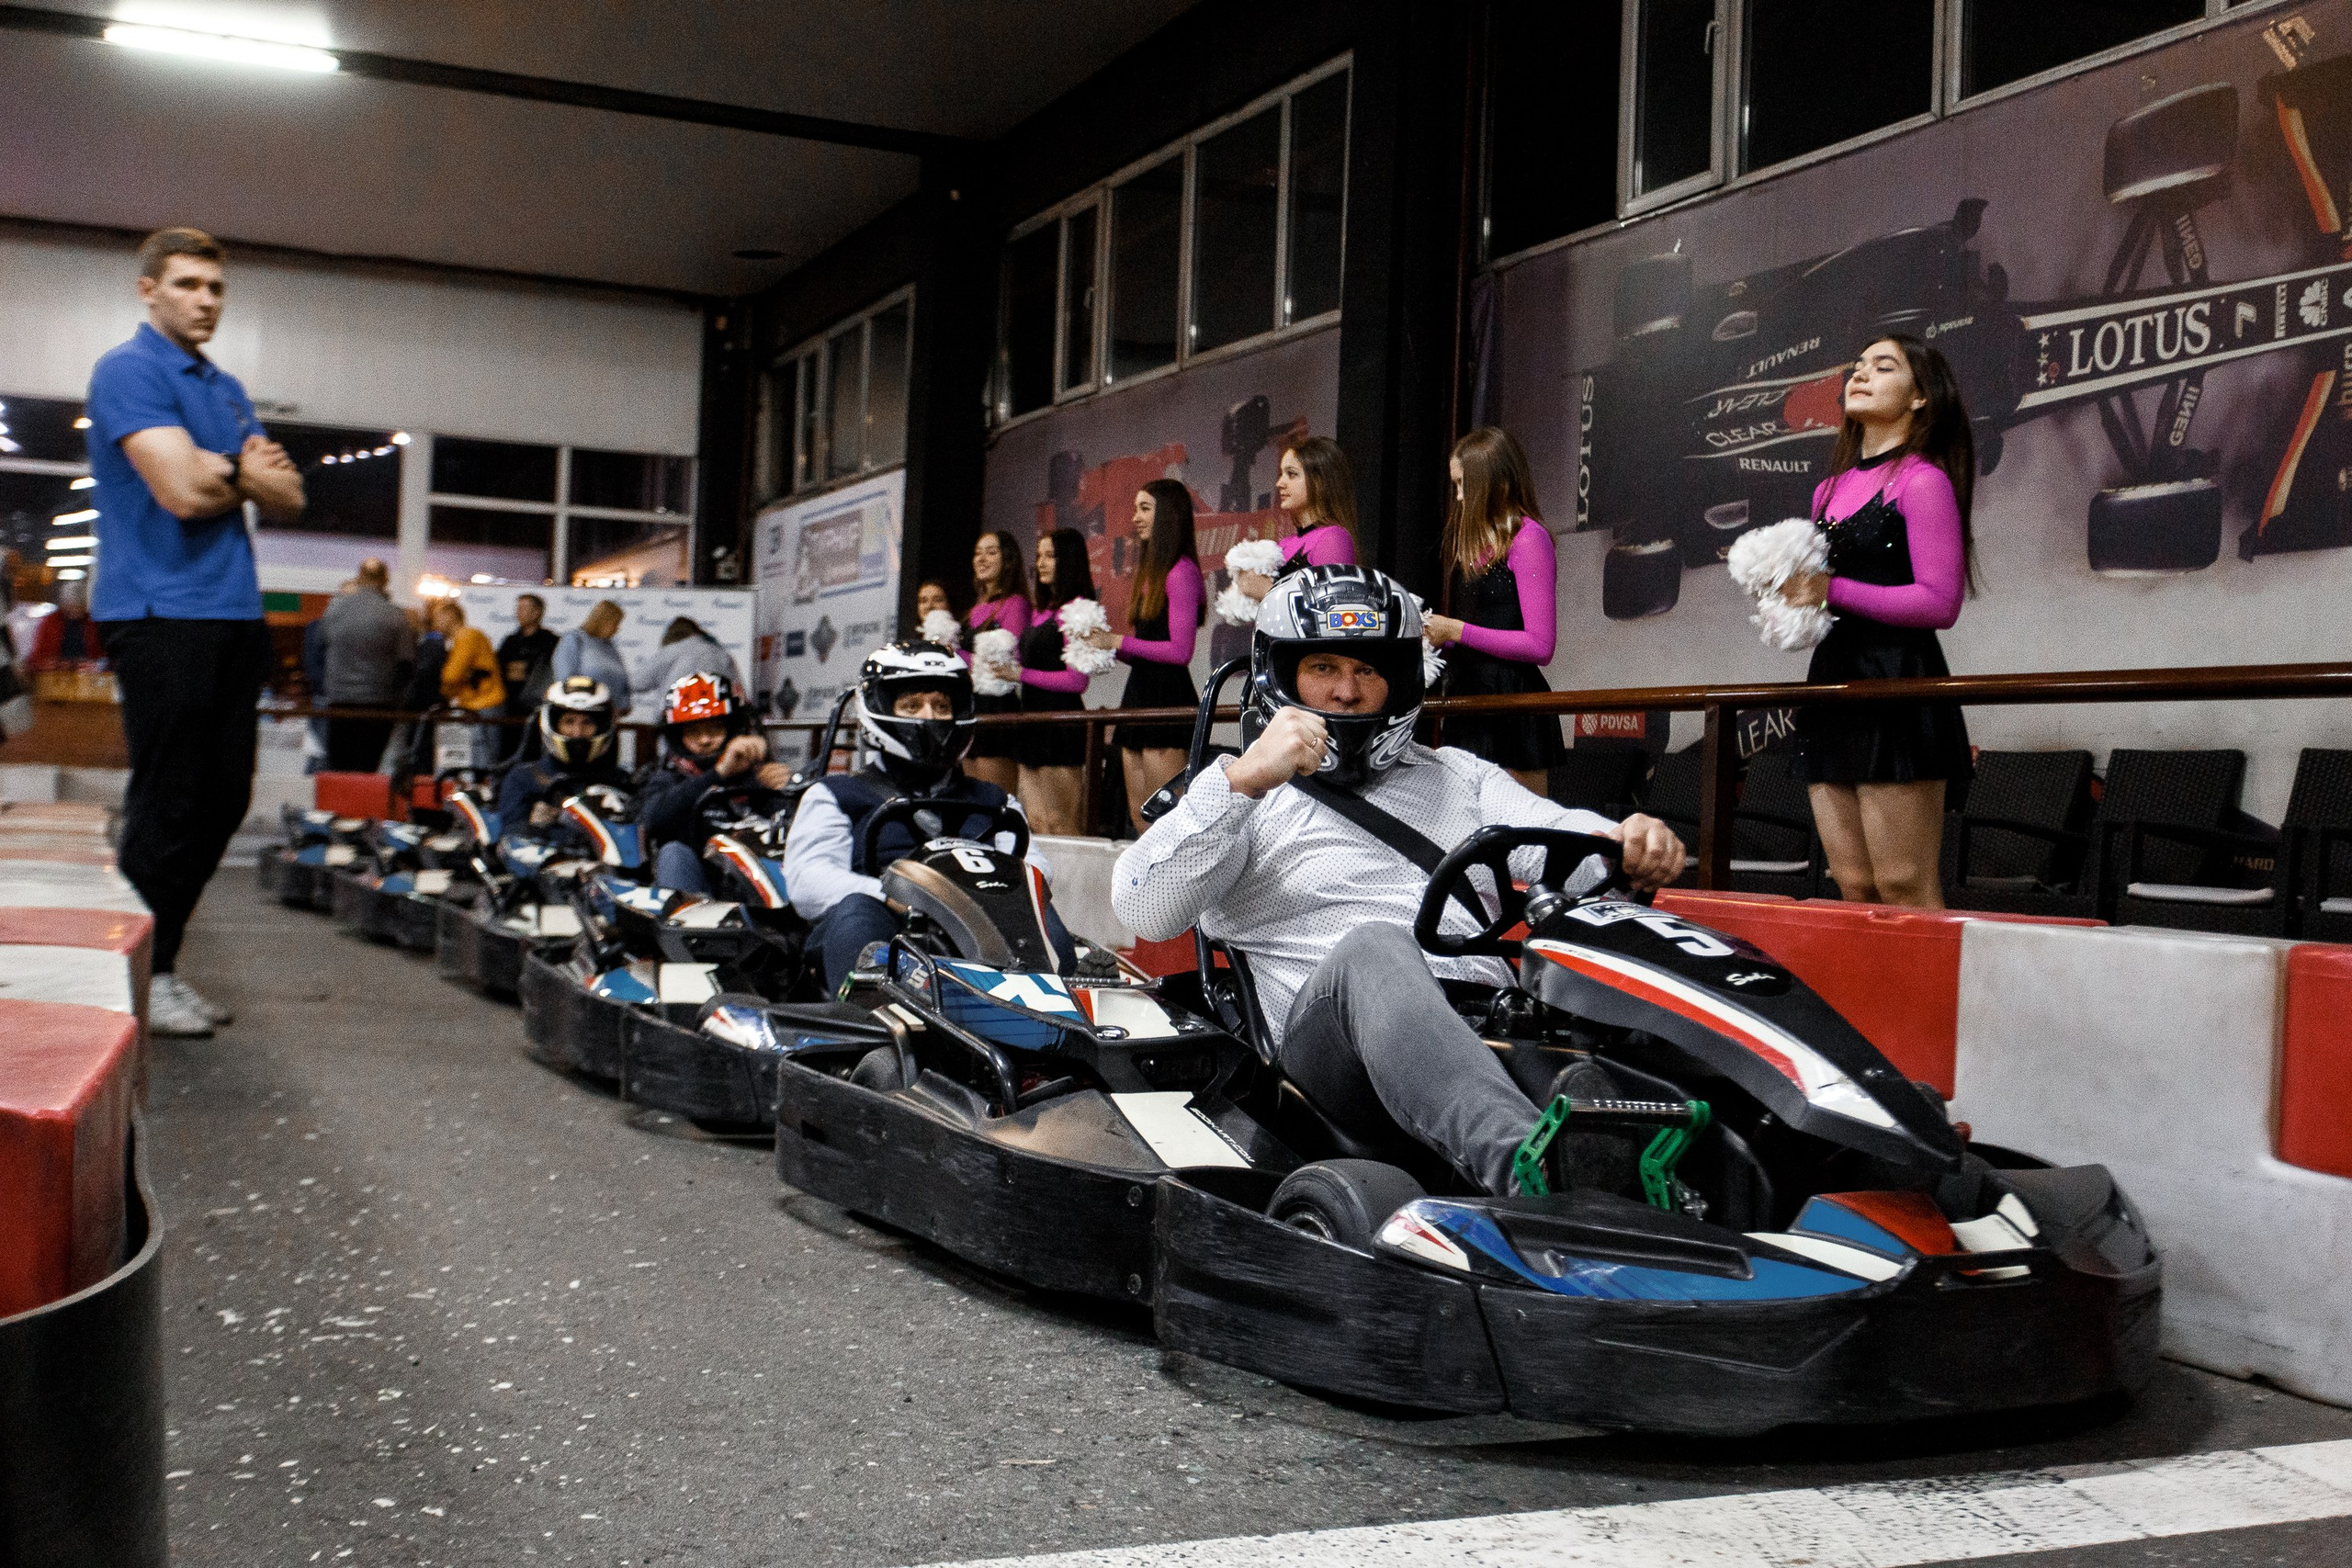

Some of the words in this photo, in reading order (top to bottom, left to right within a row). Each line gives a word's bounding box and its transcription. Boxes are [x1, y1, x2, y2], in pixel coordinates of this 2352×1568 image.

[1747, 327, 1821, 379] RENAULT
[2067, 301, 2212, 378] LOTUS
[1577, 375, 1594, 525] LOTUS
[1705, 421, 1784, 447] CLEAR
[1738, 457, 1812, 473] RENAULT
[1600, 715, 1638, 730] PDVSA
[951, 848, 996, 874] 6
[1634, 918, 1735, 956] 5
